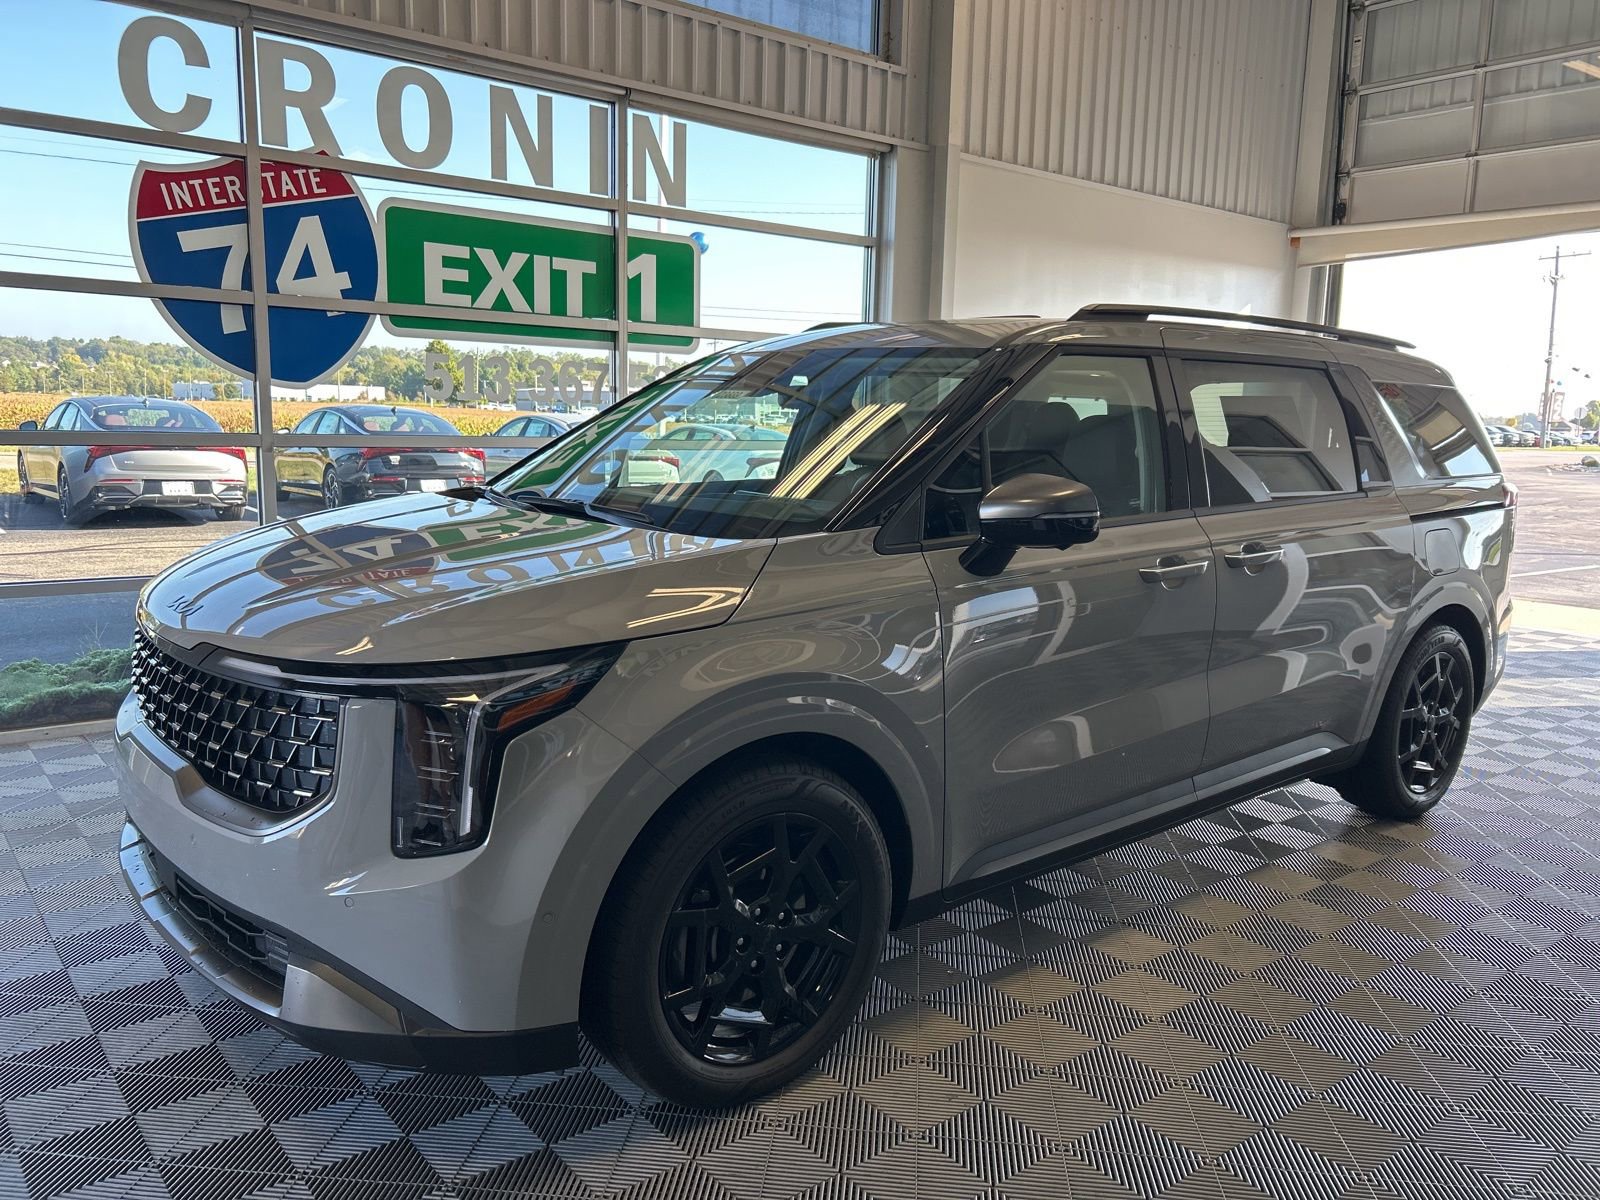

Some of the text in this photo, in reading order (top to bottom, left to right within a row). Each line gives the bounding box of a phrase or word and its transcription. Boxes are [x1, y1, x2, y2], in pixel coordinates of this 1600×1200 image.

[118, 15, 687, 208] CRONIN
[160, 168, 327, 211] INTERTATE
[177, 215, 352, 334] 74
[424, 242, 657, 323] EXIT 1
